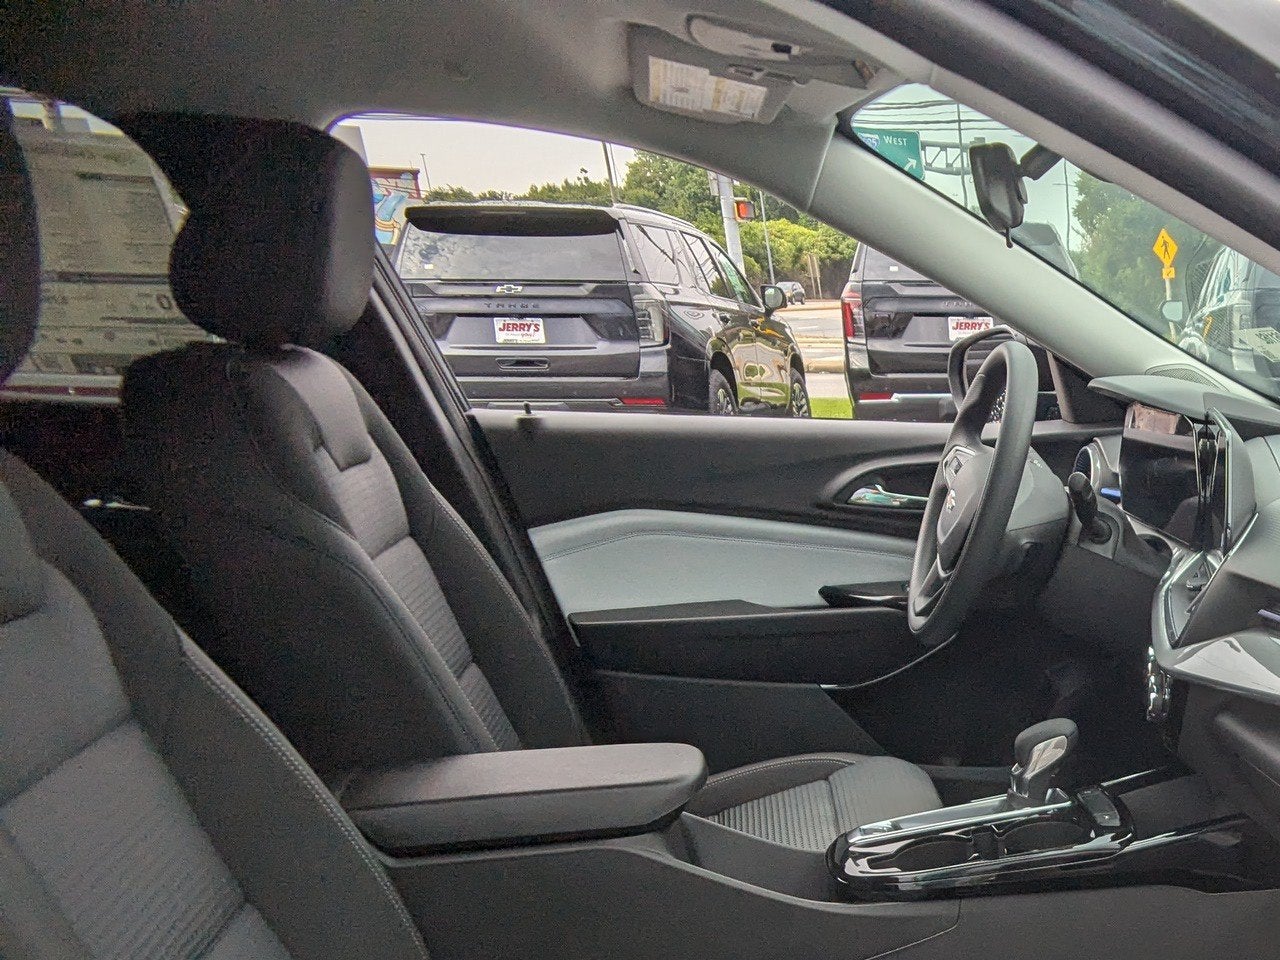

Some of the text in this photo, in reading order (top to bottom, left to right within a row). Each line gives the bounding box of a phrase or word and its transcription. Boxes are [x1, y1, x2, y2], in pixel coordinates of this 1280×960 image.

[883, 135, 907, 146] WEST
[498, 322, 541, 332] JERRY'S
[952, 321, 991, 331] JERRY'S
